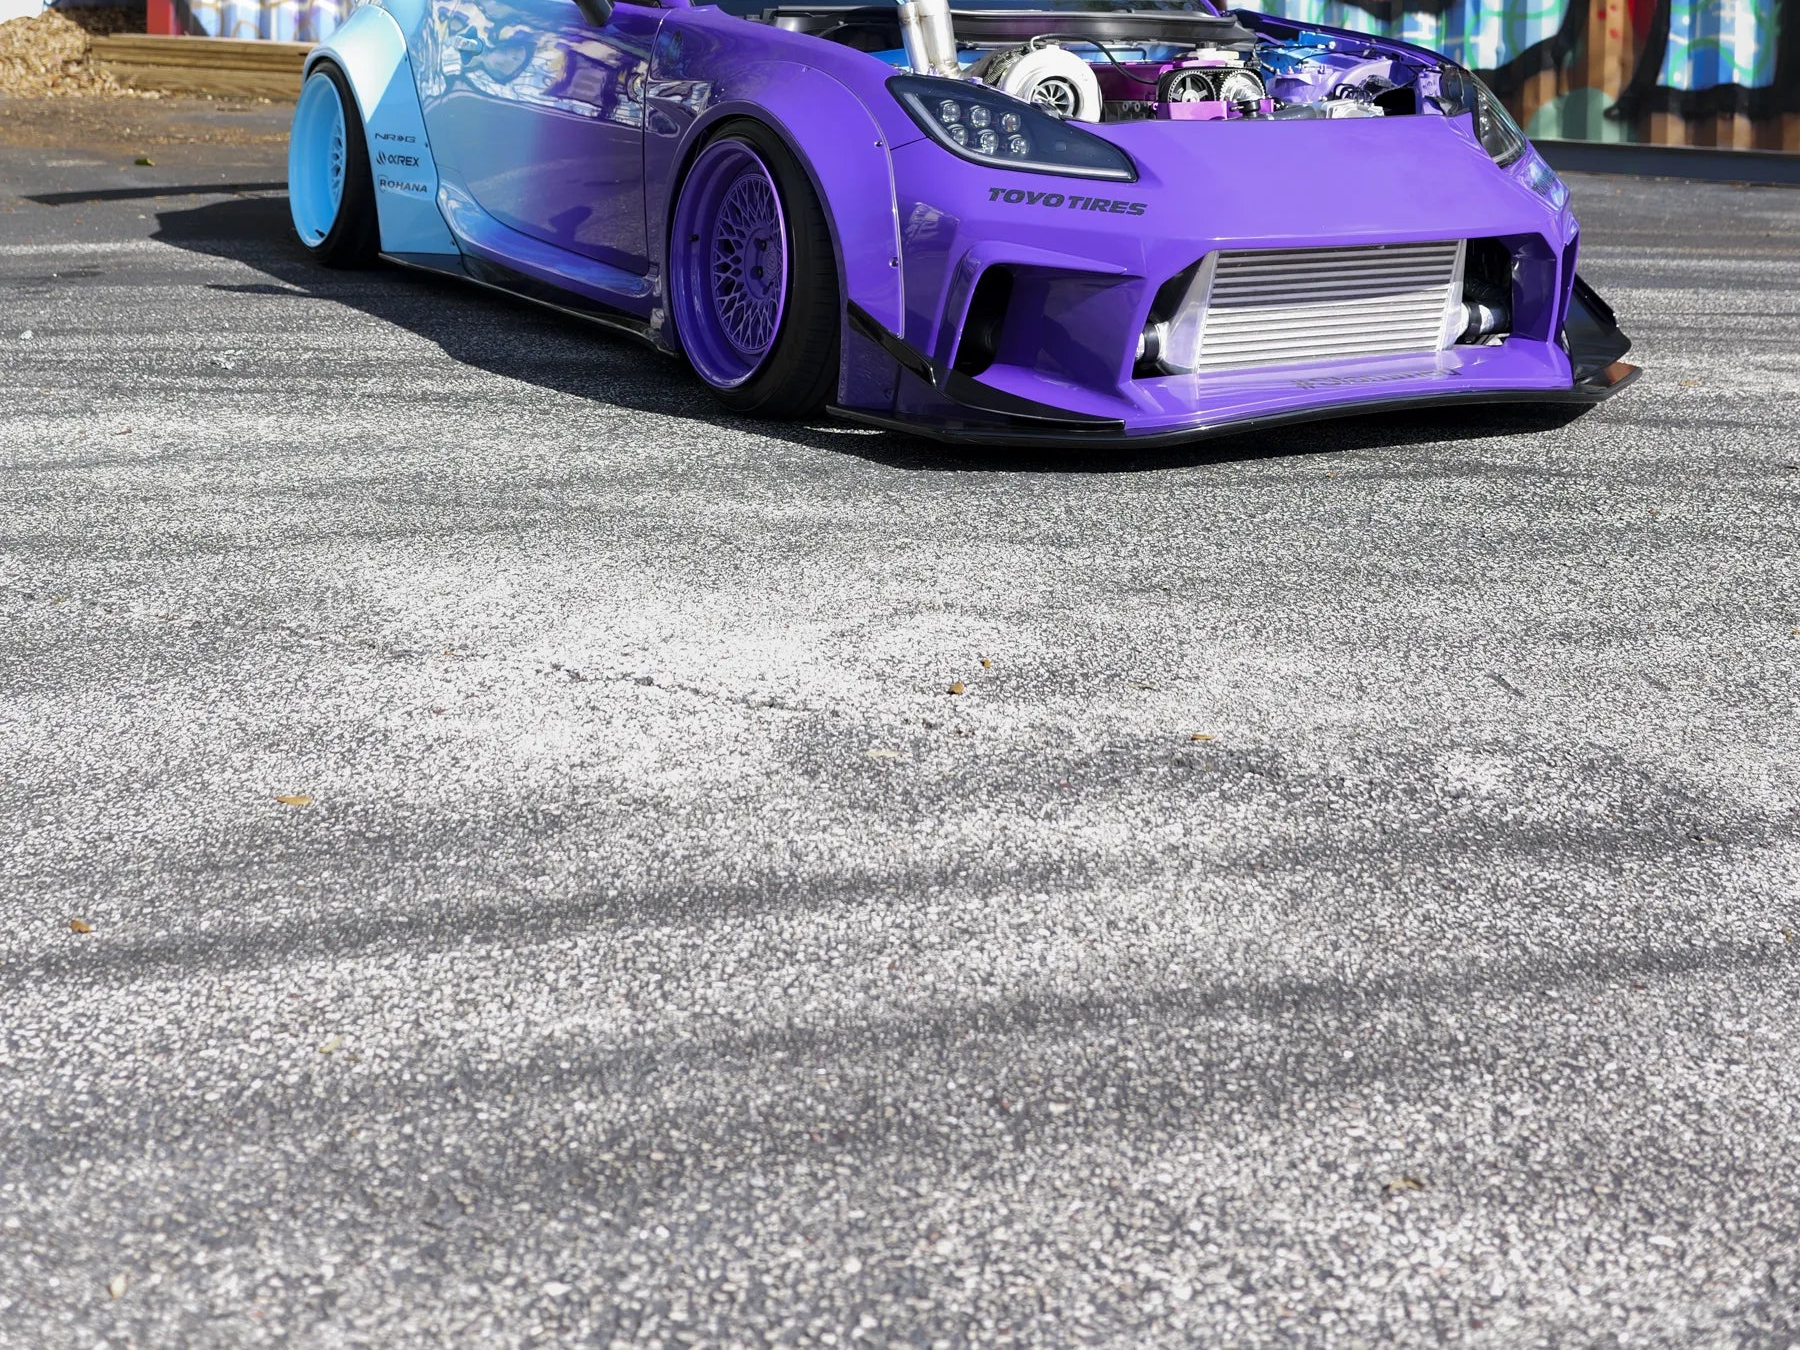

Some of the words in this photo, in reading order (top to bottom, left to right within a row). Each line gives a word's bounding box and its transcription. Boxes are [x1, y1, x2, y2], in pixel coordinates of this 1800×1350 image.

[379, 178, 428, 193] ROHANA
[988, 187, 1065, 208] TOYO
[1067, 195, 1149, 216] TIRES
